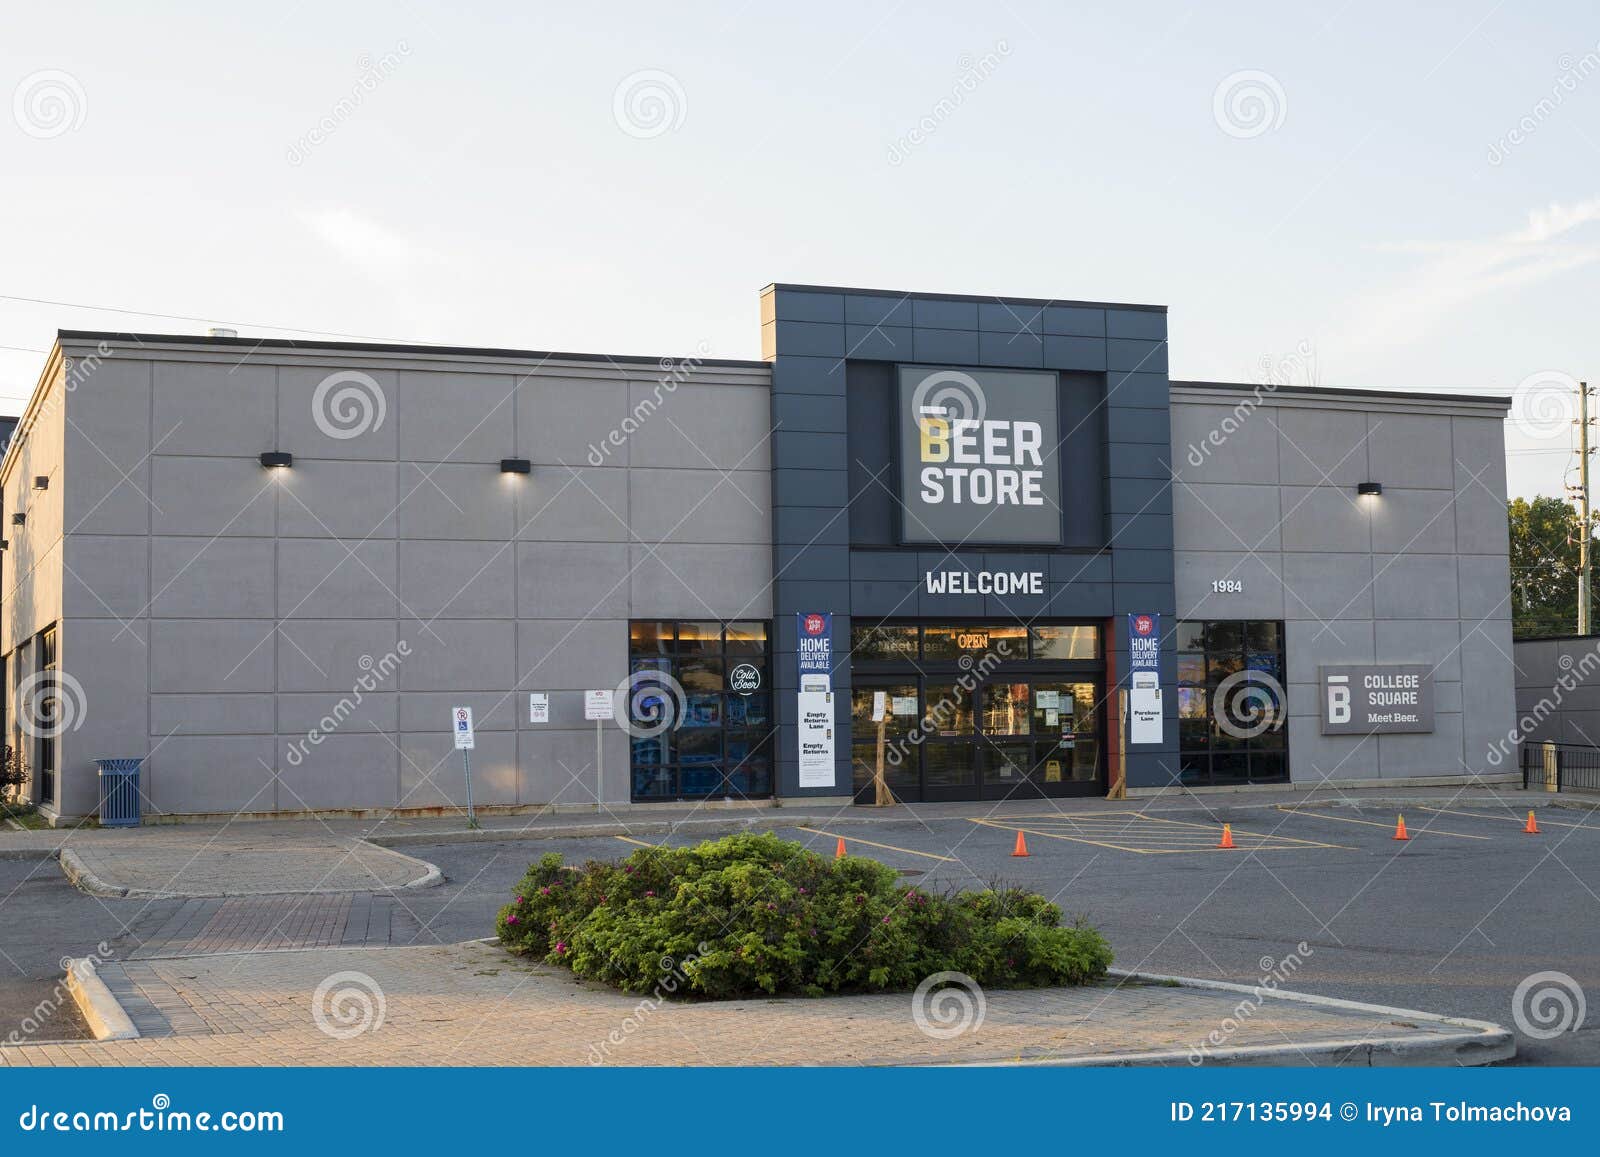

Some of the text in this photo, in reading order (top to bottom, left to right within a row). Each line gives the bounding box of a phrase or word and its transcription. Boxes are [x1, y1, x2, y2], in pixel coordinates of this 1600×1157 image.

[919, 417, 1043, 466] BEER
[920, 467, 1044, 506] STORE
[926, 571, 1044, 594] WELCOME
[1211, 580, 1242, 592] 1984
[800, 638, 830, 652] HOME
[957, 633, 988, 649] OPEN
[1131, 638, 1158, 651] HOME
[800, 652, 830, 661] DELIVERY
[1131, 651, 1158, 660] DELIVERY
[800, 661, 830, 669] AVAILABLE
[1131, 659, 1158, 667] AVAILABLE
[735, 669, 756, 680] Cold
[734, 678, 758, 690] Beer
[1364, 675, 1419, 688] COLLEGE
[1368, 691, 1418, 706] SQUARE
[1367, 713, 1419, 723] Meet Beer.
